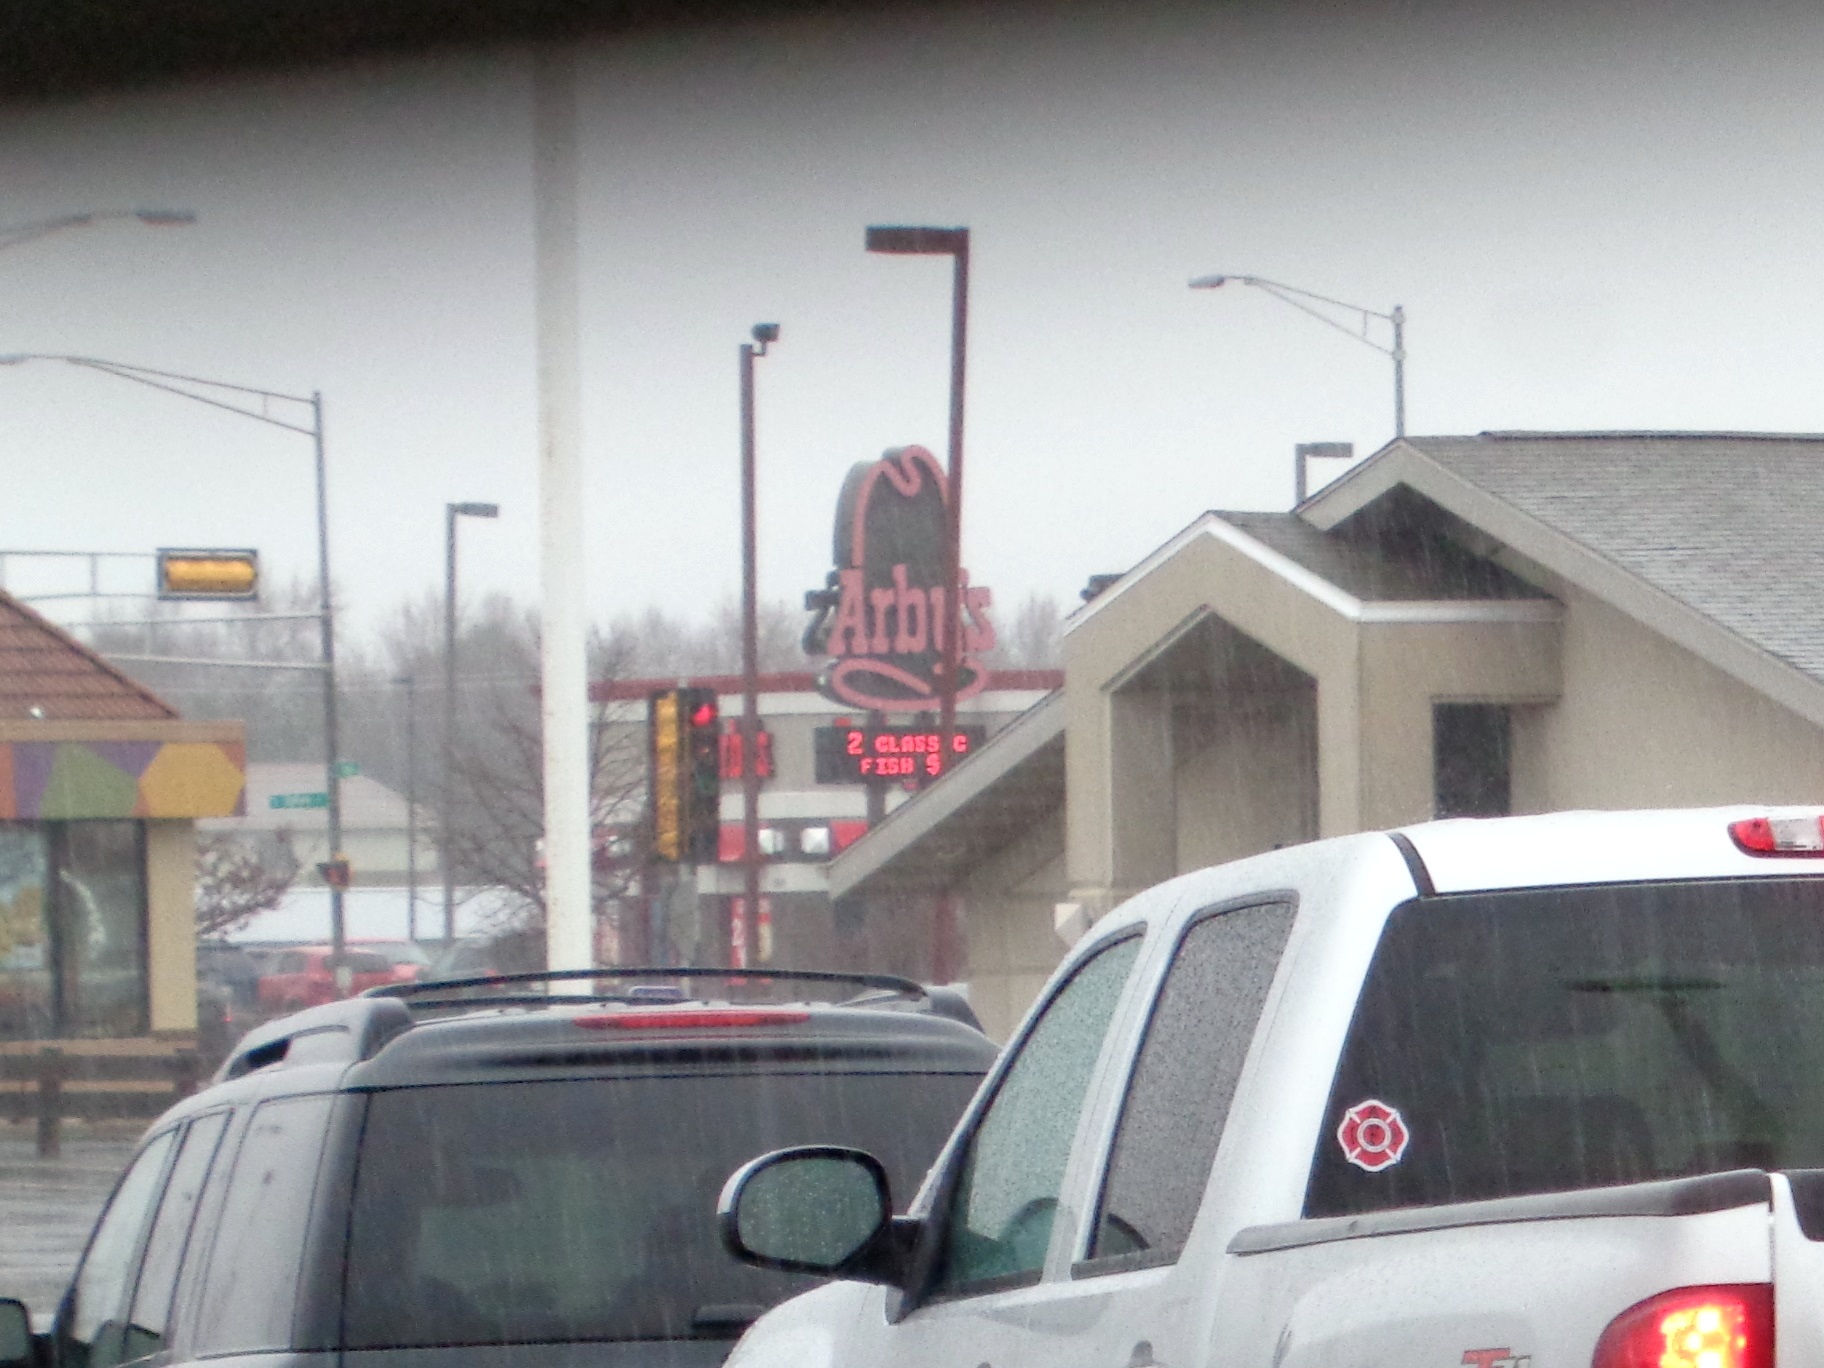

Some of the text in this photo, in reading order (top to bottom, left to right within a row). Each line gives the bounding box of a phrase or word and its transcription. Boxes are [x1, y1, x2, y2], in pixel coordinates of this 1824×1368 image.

[847, 731, 968, 755] 2 CLASSC
[860, 757, 915, 776] FISH
